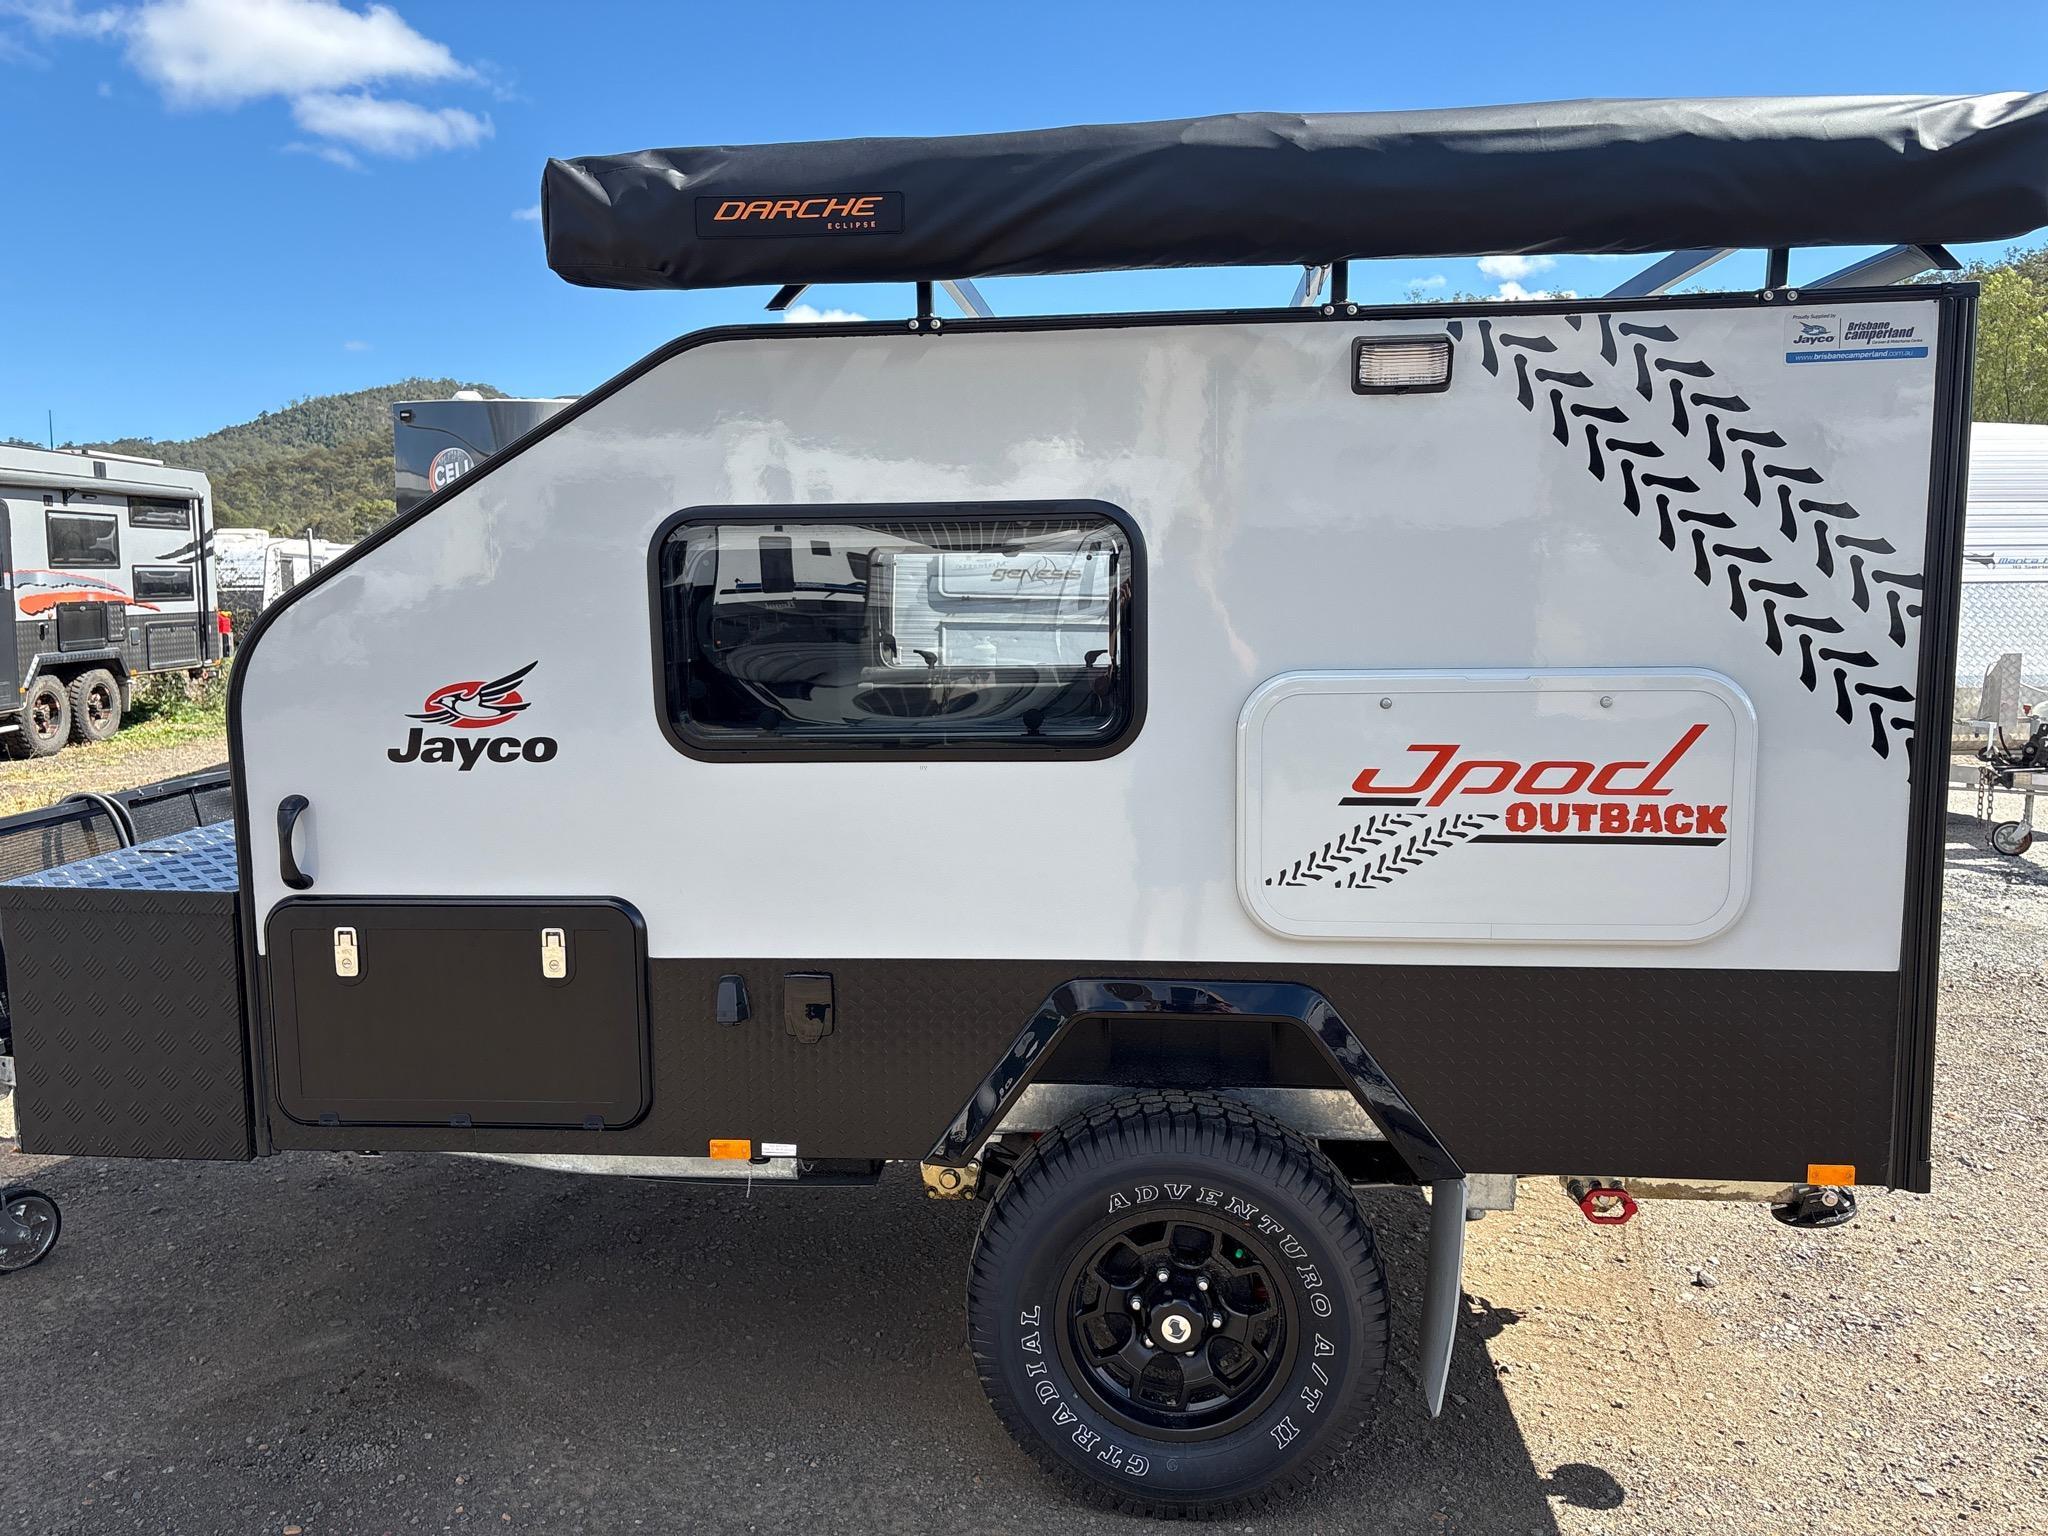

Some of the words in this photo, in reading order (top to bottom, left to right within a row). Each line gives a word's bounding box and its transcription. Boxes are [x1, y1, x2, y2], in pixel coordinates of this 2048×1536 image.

[713, 197, 884, 221] DARCHE
[827, 220, 877, 230] ECLIPSE
[1847, 321, 1891, 331] Brisbane
[1793, 335, 1835, 345] Jayco
[1795, 349, 1914, 361] www.brisbanecamperland.com.au
[387, 727, 558, 772] Jayco
[1351, 723, 1710, 807] Jpod
[1505, 801, 1728, 835] OUTBACK
[1106, 1182, 1333, 1318] ADVENTURO
